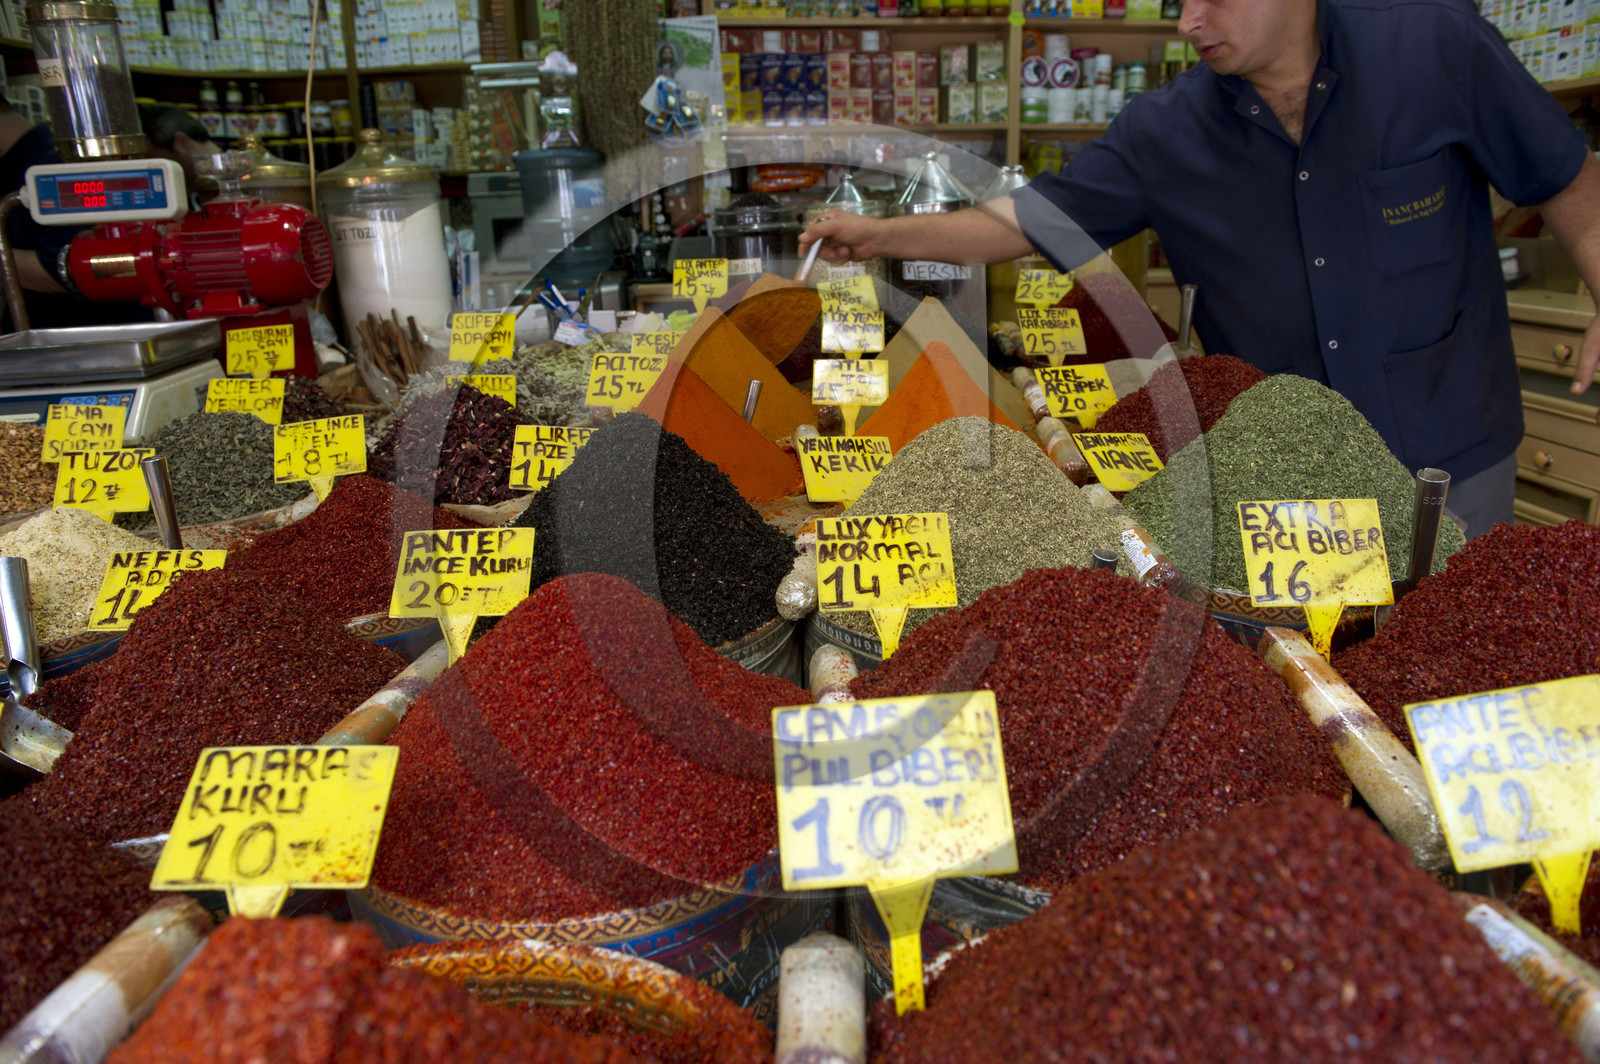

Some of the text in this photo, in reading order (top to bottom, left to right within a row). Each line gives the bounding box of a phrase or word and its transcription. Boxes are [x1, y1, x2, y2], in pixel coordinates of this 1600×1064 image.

[686, 269, 725, 279] SUMAK
[674, 278, 697, 298] 15
[1017, 283, 1044, 300] 26
[1025, 332, 1056, 355] 25
[592, 374, 645, 400] 15 TL
[51, 405, 103, 420] ELMA
[1057, 395, 1087, 414] 20
[515, 441, 568, 459] TAZE
[1092, 449, 1160, 473] NANE
[511, 459, 555, 489] 14
[62, 477, 97, 504] 12
[1239, 501, 1349, 532] EXTRA
[405, 529, 517, 558] ANTEP
[818, 540, 942, 564] NORMAL
[111, 550, 204, 570] NEFİS
[469, 555, 532, 577] KURU
[405, 580, 460, 610] 20
[822, 563, 881, 610] 14
[1254, 560, 1312, 604] 16
[189, 783, 308, 820] KURU
[1458, 779, 1552, 854] 12
[791, 795, 907, 882] 10
[164, 821, 278, 886] 10
